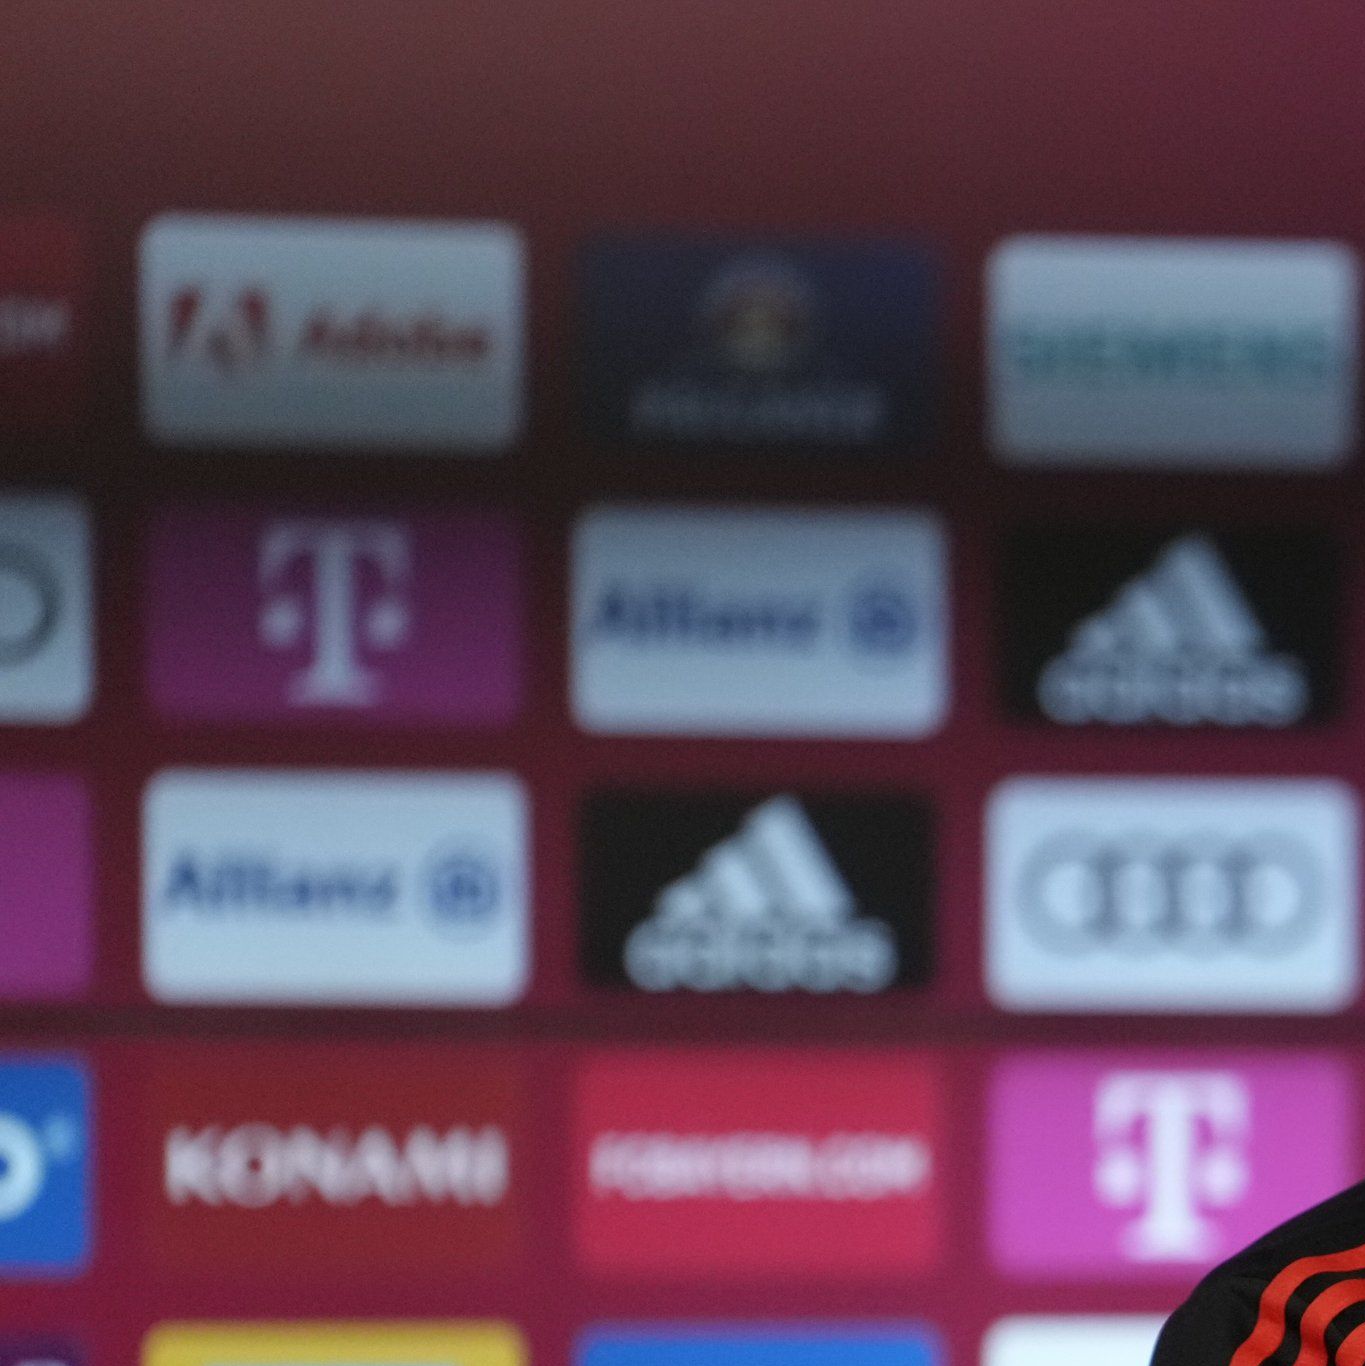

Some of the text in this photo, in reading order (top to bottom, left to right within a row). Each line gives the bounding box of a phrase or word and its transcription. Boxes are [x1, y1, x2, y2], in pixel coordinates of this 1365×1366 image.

[600, 584, 818, 650] Allianz
[1039, 650, 1310, 726] adidas
[168, 853, 395, 917] Allianz
[625, 918, 897, 993] adidas
[165, 1122, 510, 1209] KONAMI
